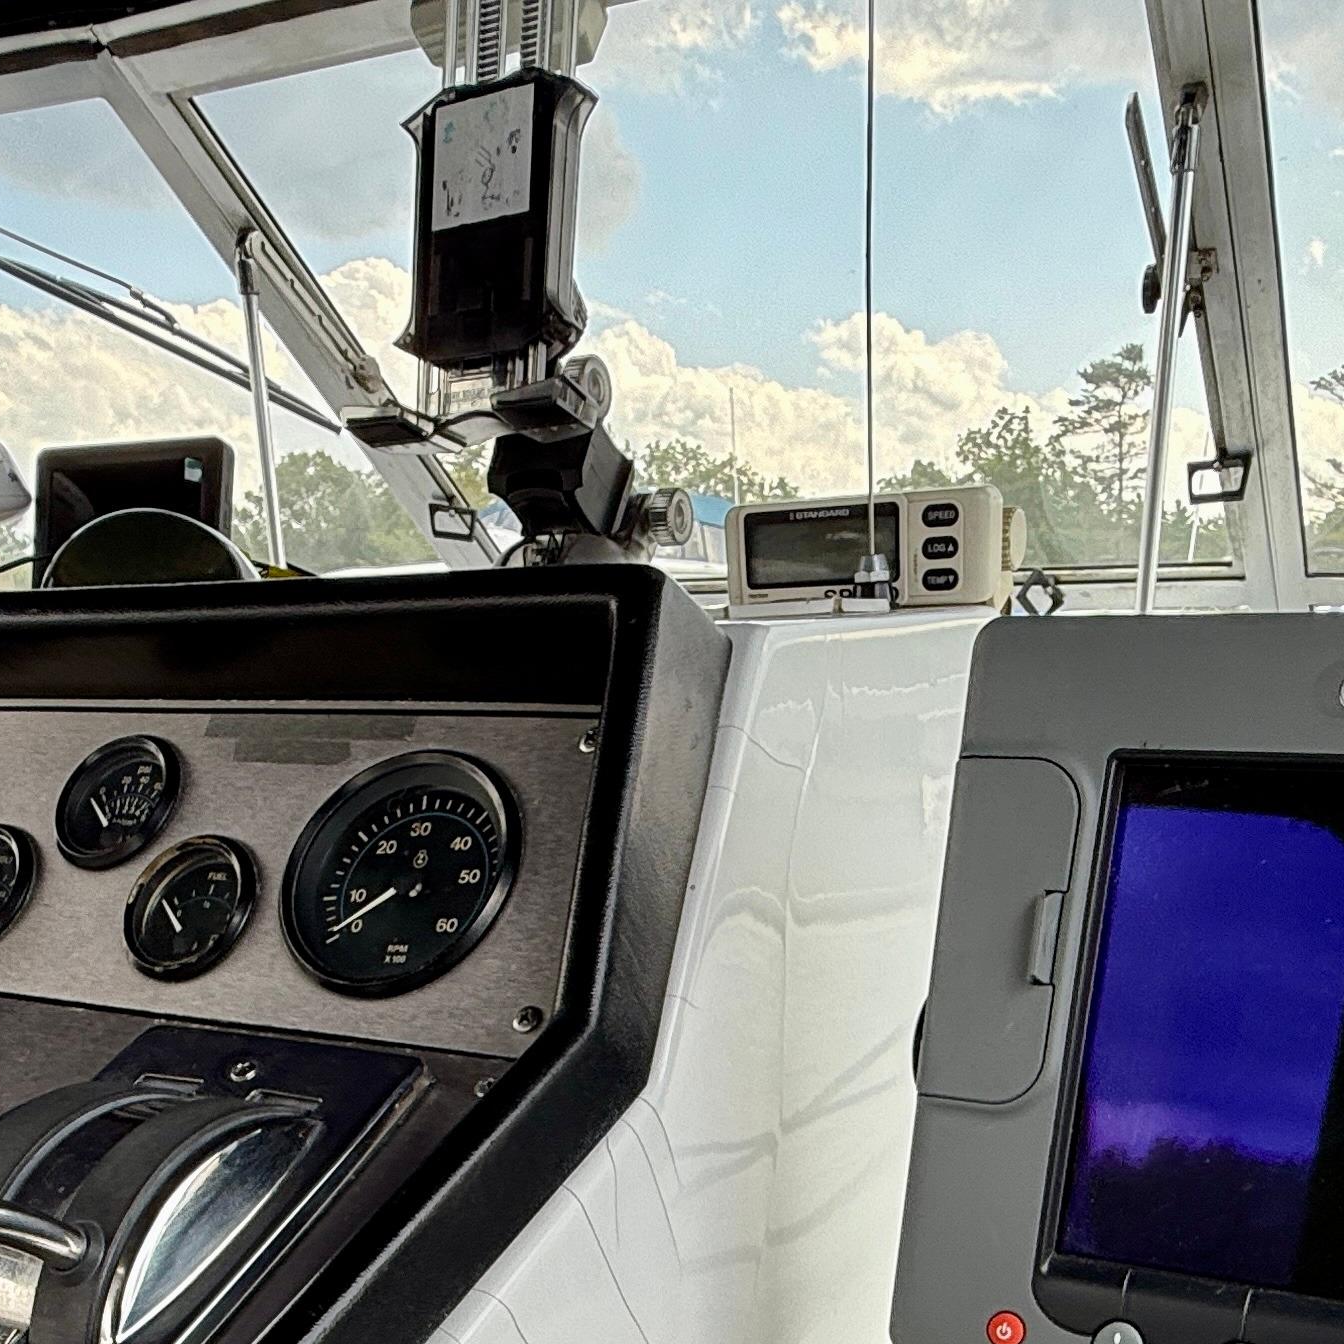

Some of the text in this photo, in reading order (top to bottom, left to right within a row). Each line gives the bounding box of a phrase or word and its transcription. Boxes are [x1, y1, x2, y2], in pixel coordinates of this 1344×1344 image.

[928, 510, 956, 521] SPEED
[927, 544, 946, 553] LOG
[927, 575, 948, 585] TEMP
[410, 822, 432, 837] 30
[376, 840, 397, 855] 20
[450, 836, 472, 851] 40
[458, 869, 481, 884] 50
[349, 888, 367, 903] 10
[351, 919, 363, 933] 0
[436, 918, 458, 933] 60
[387, 944, 408, 954] RPM
